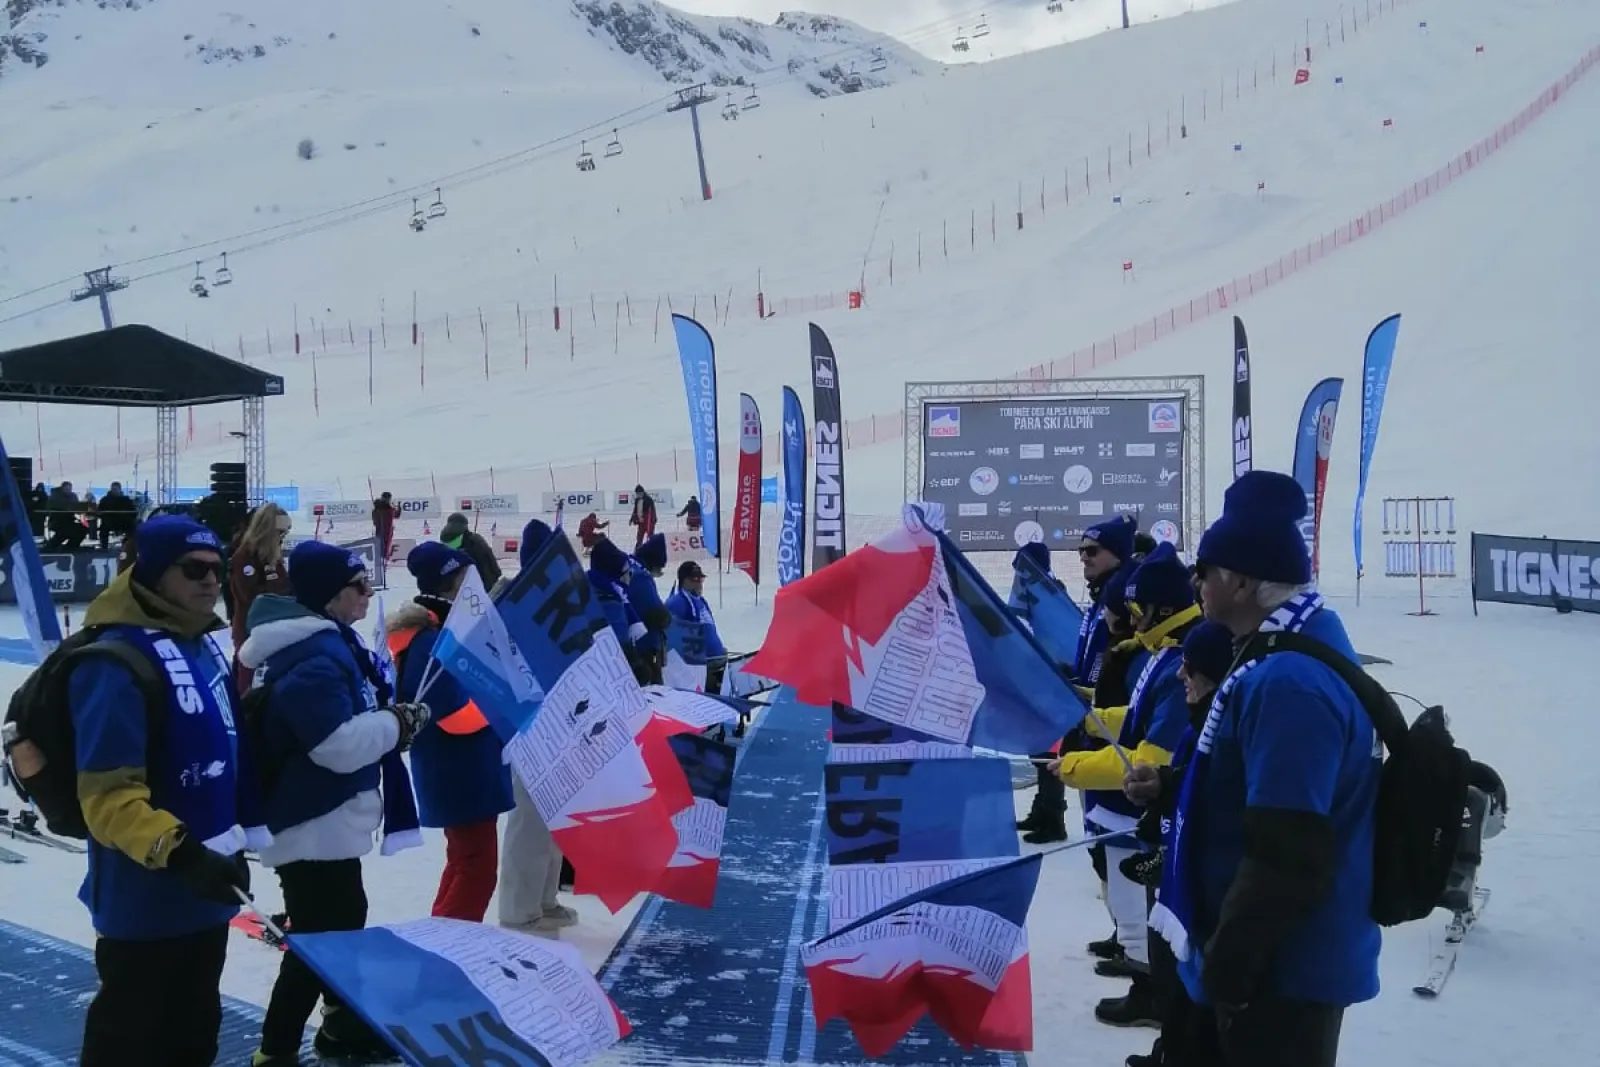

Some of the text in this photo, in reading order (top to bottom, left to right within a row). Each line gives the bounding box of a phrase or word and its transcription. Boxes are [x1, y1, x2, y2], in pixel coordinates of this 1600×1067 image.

[1014, 416, 1093, 429] PARA SKI ALPIN
[739, 475, 752, 541] savoie
